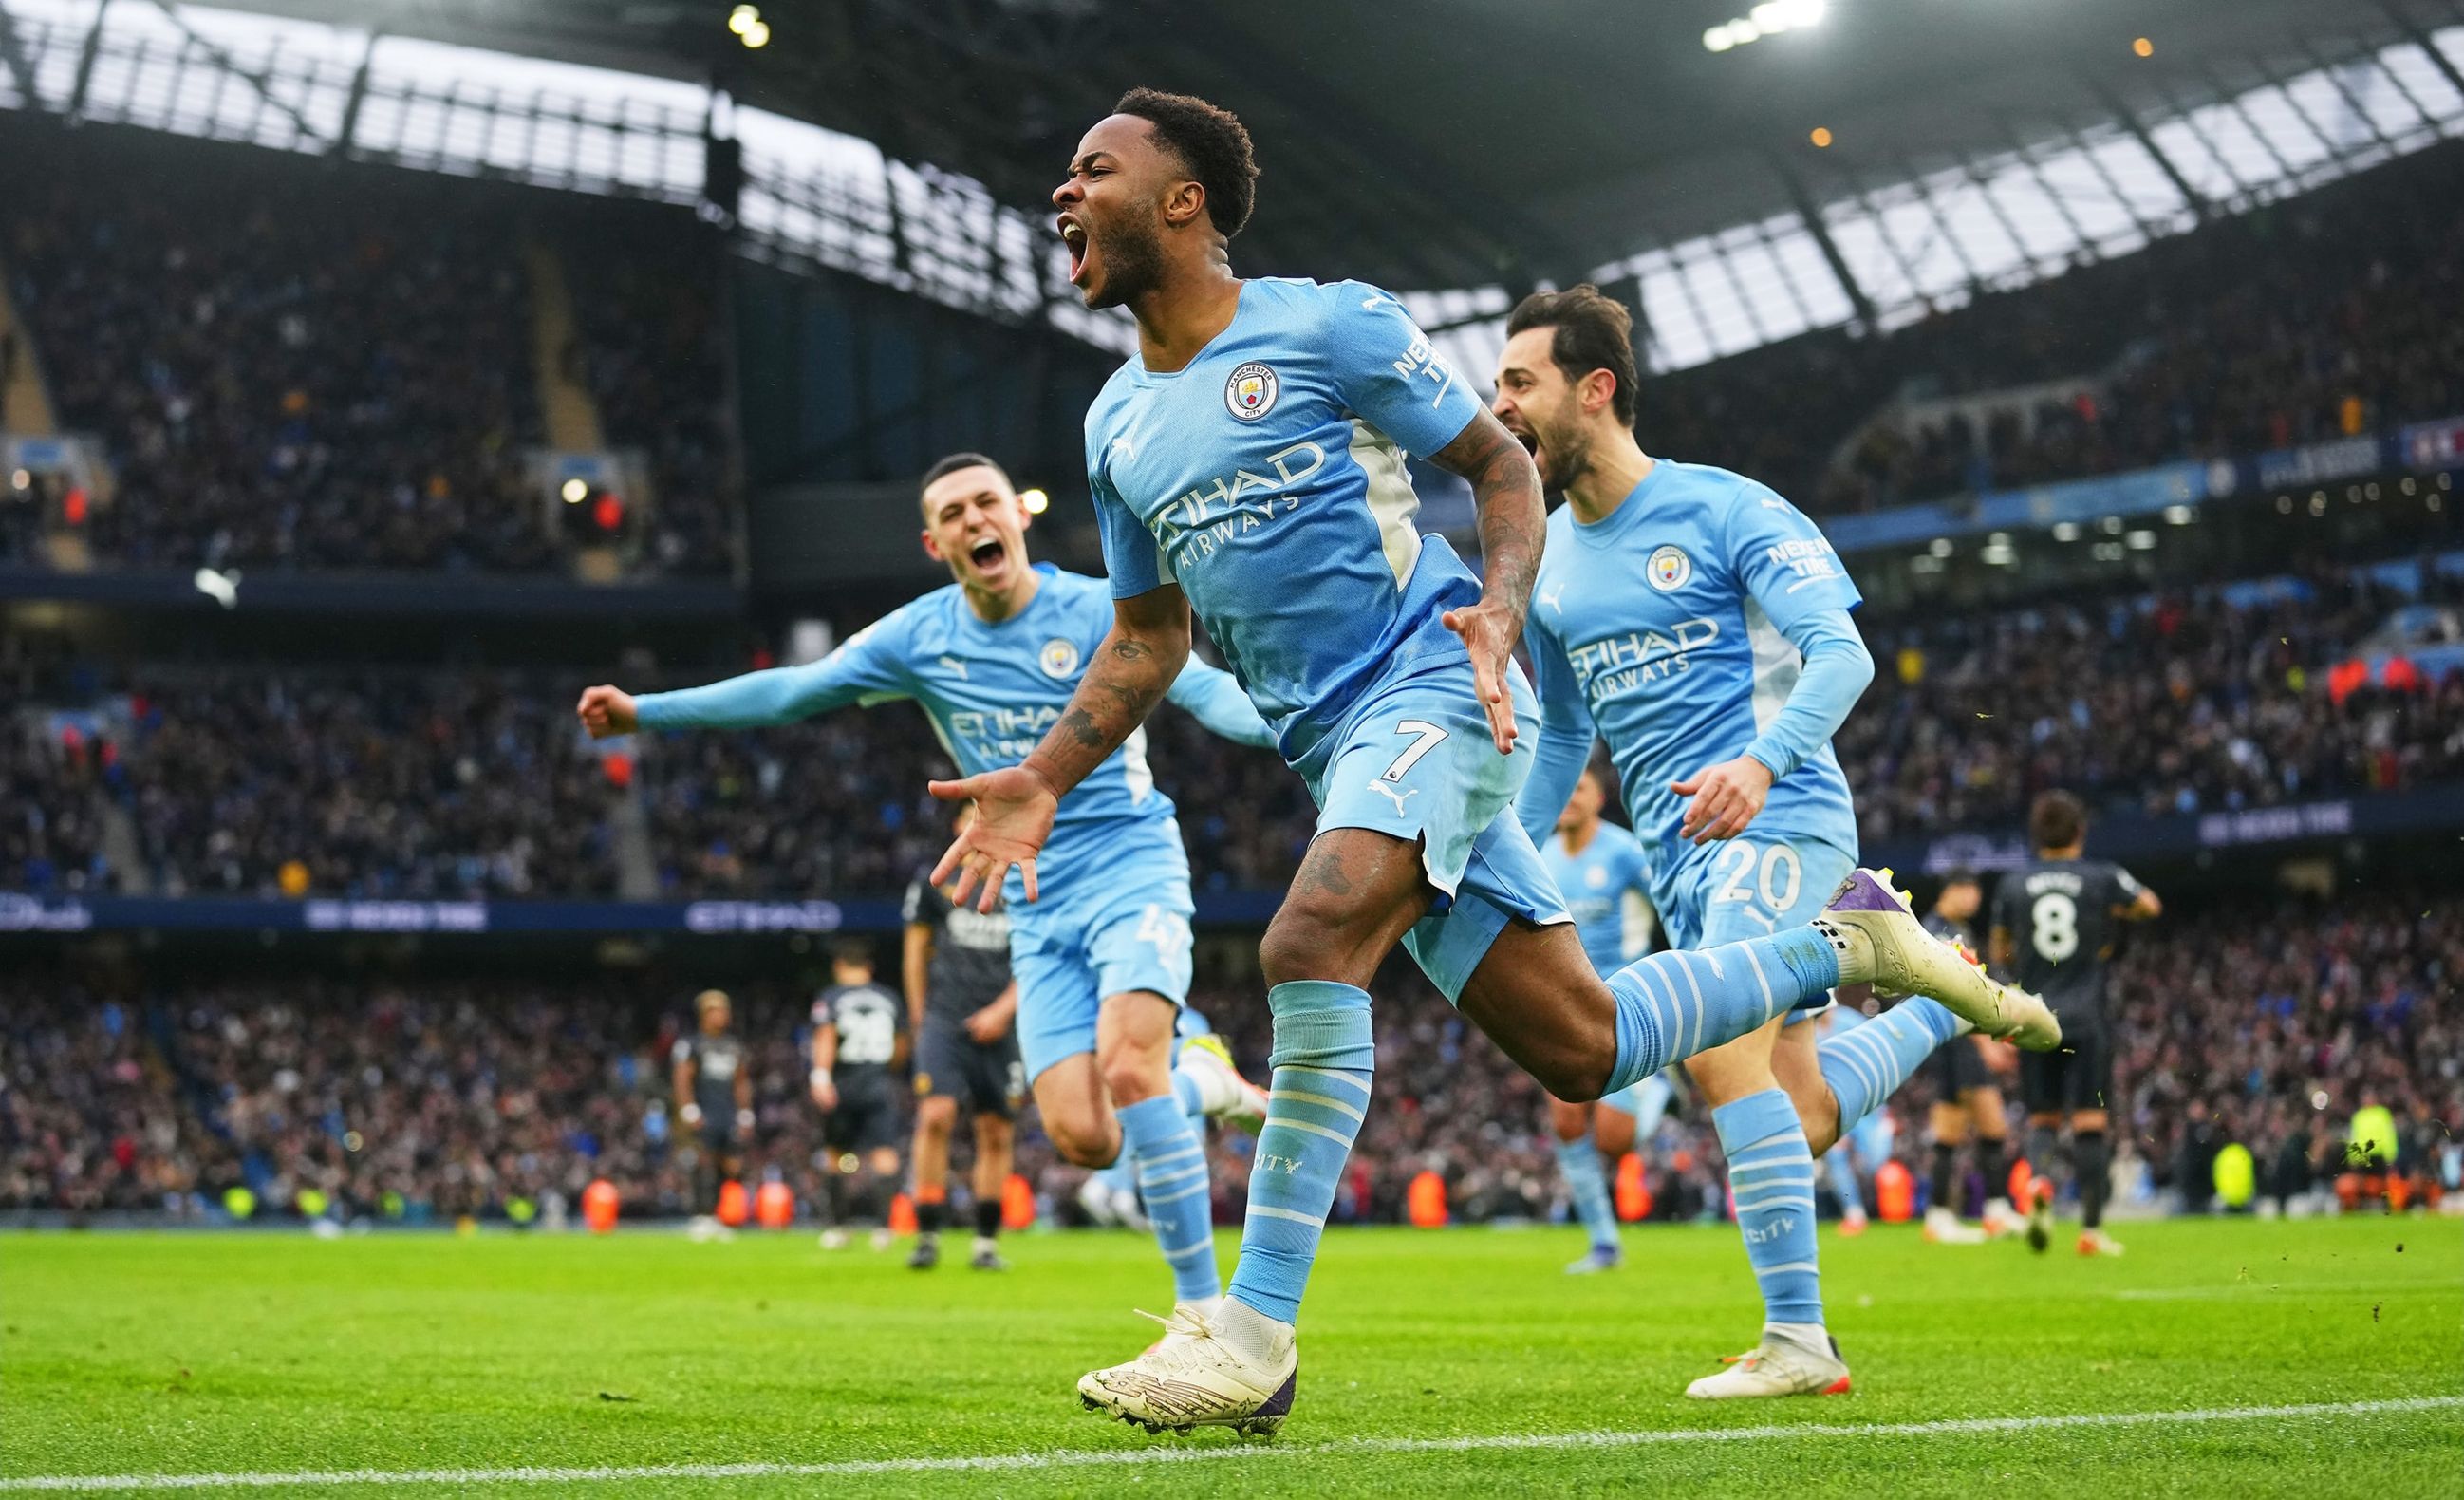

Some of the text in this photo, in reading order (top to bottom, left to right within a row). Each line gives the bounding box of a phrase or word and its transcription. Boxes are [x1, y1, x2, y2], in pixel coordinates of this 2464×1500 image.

[1229, 366, 1273, 389] MANCHESTER
[1244, 408, 1261, 418] CITY
[1148, 441, 1326, 553] ETIHAD
[1179, 492, 1299, 571] AIRWAYS
[1788, 556, 1836, 577] TIRE
[1567, 616, 1720, 680] ETIHAD
[1380, 719, 1450, 784] 7
[1712, 838, 1802, 912] 20
[2031, 892, 2080, 963] 8
[1747, 1216, 1795, 1244] CITY
